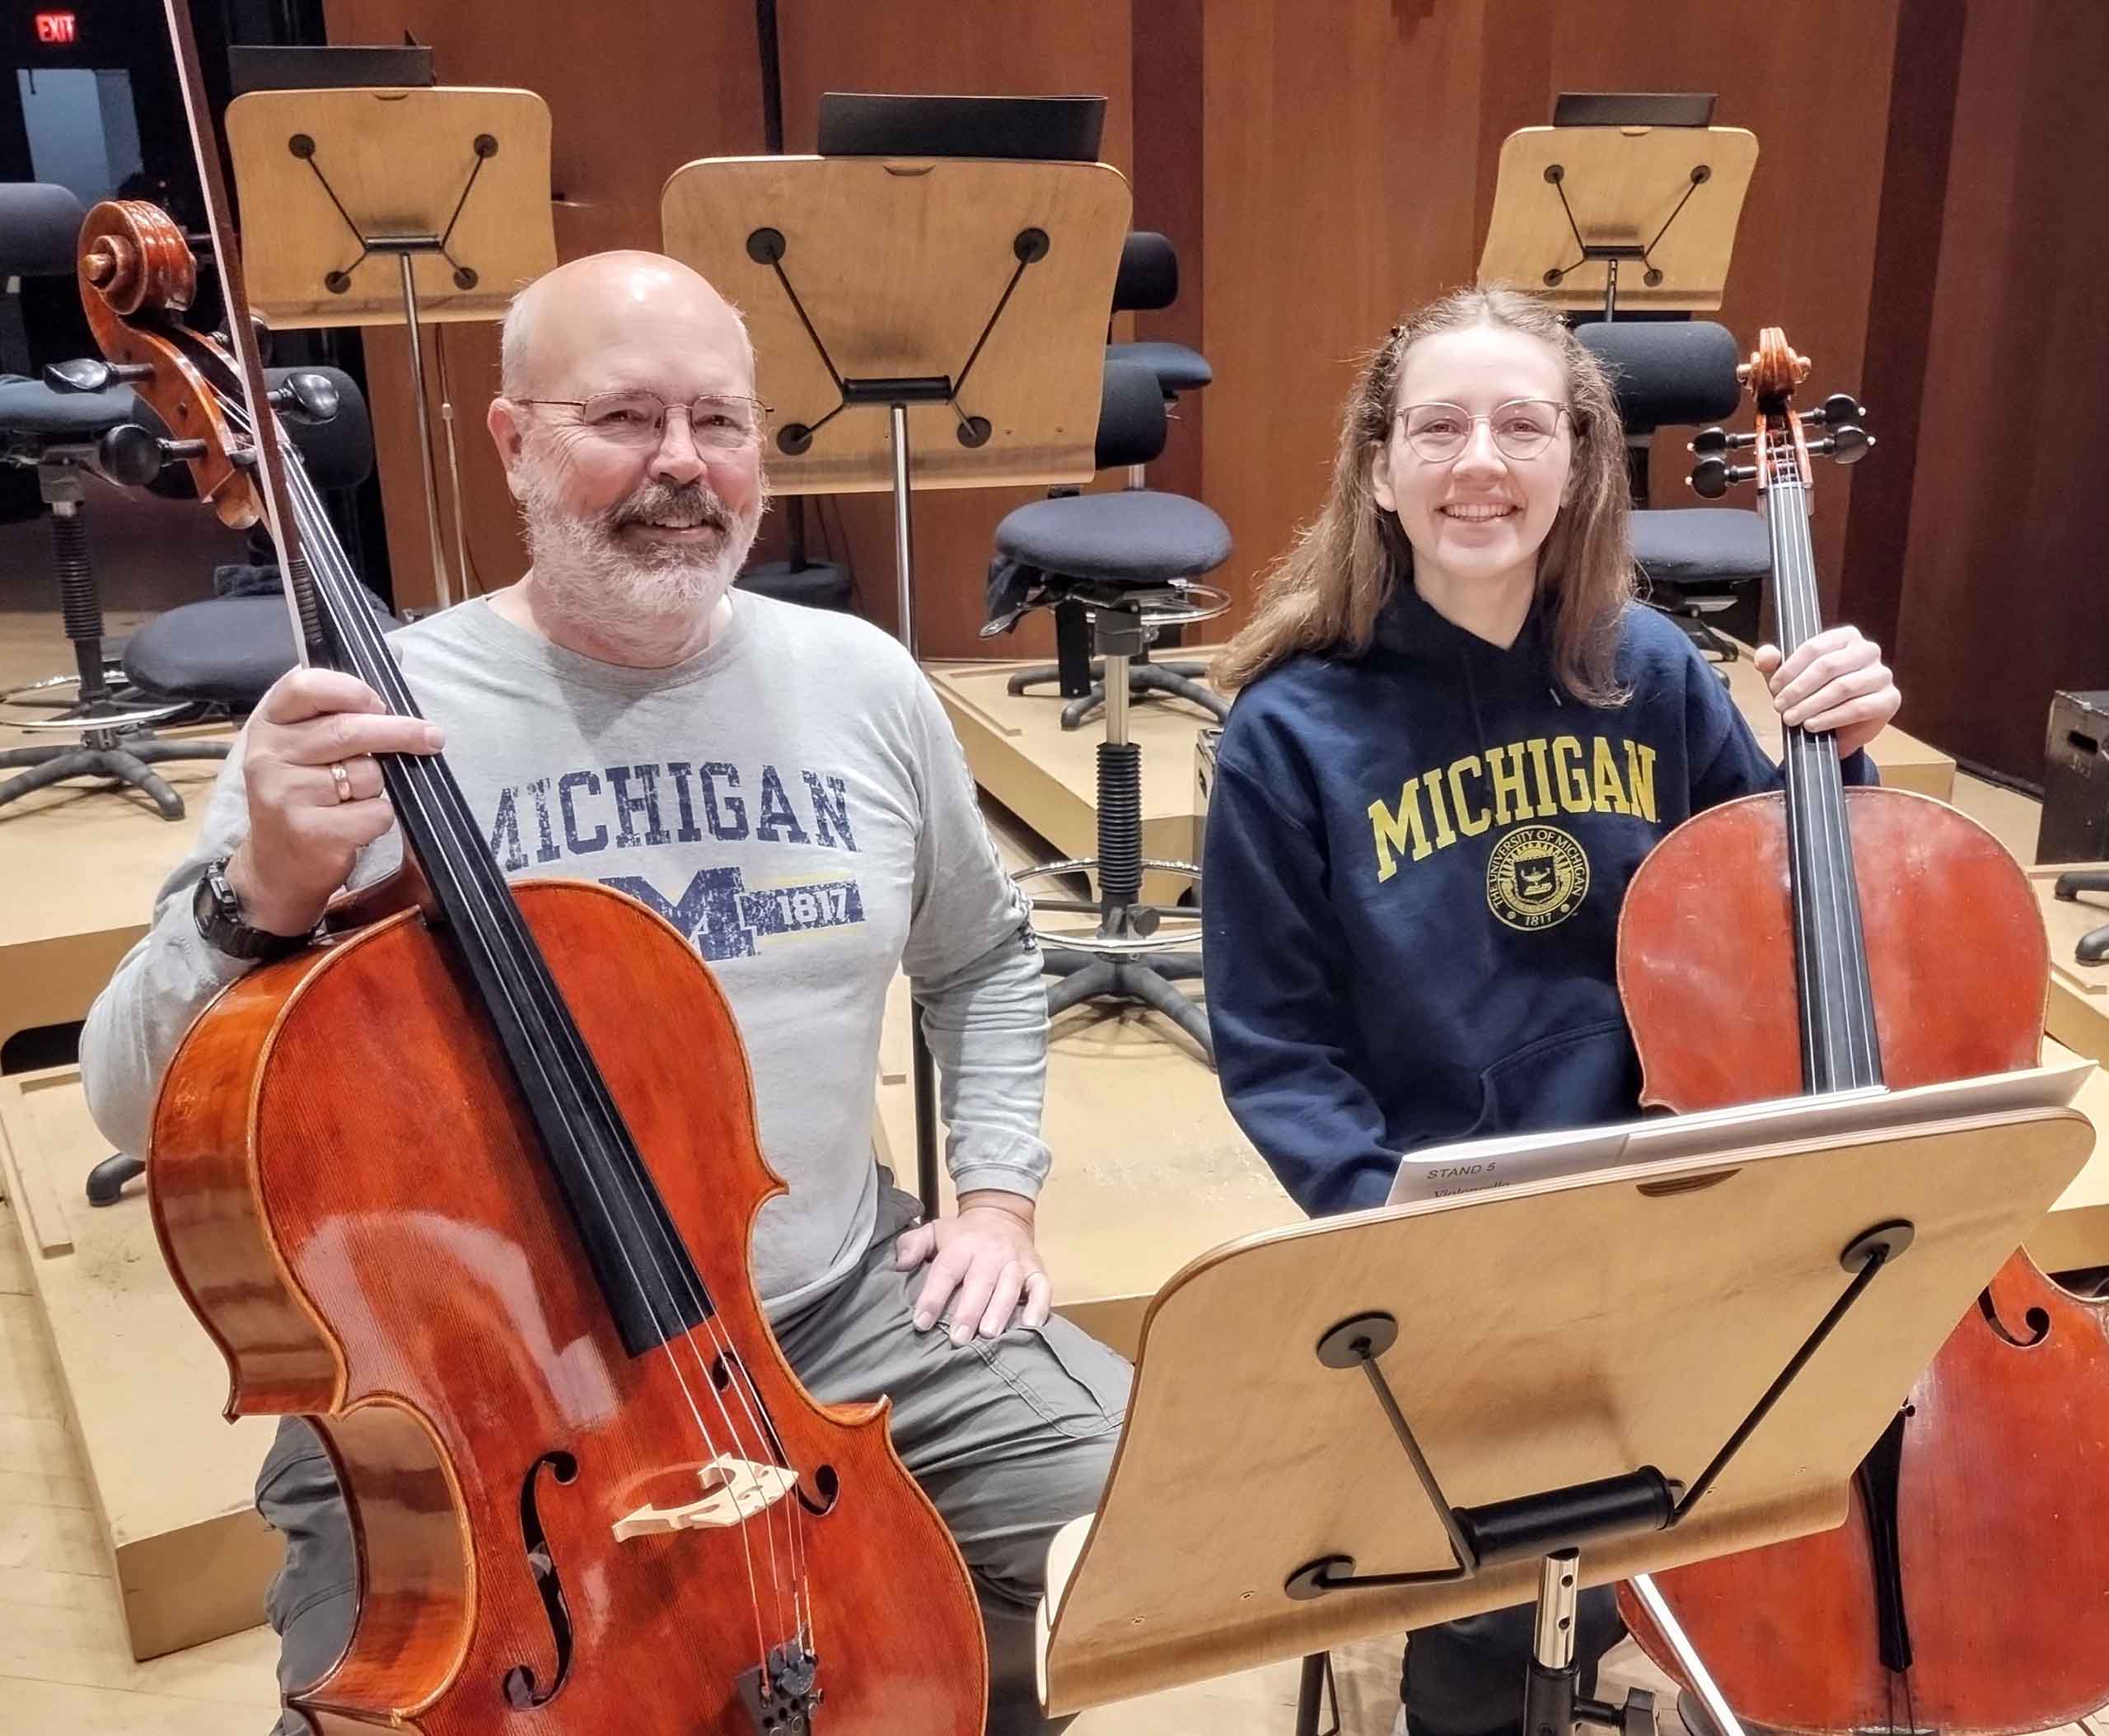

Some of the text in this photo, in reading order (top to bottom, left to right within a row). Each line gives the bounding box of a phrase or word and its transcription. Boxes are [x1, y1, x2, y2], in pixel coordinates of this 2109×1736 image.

[36, 14, 75, 42] EXIT
[1368, 736, 1656, 883] MICHIGAN
[1536, 830, 1556, 841] OF
[1490, 830, 1534, 883] UNIVERSITY
[1555, 835, 1586, 896] MICHIGAN
[777, 887, 847, 924] 1817
[1489, 884, 1503, 909] THE
[1526, 913, 1552, 926] 1817
[1427, 1162, 1497, 1180] STAND 5
